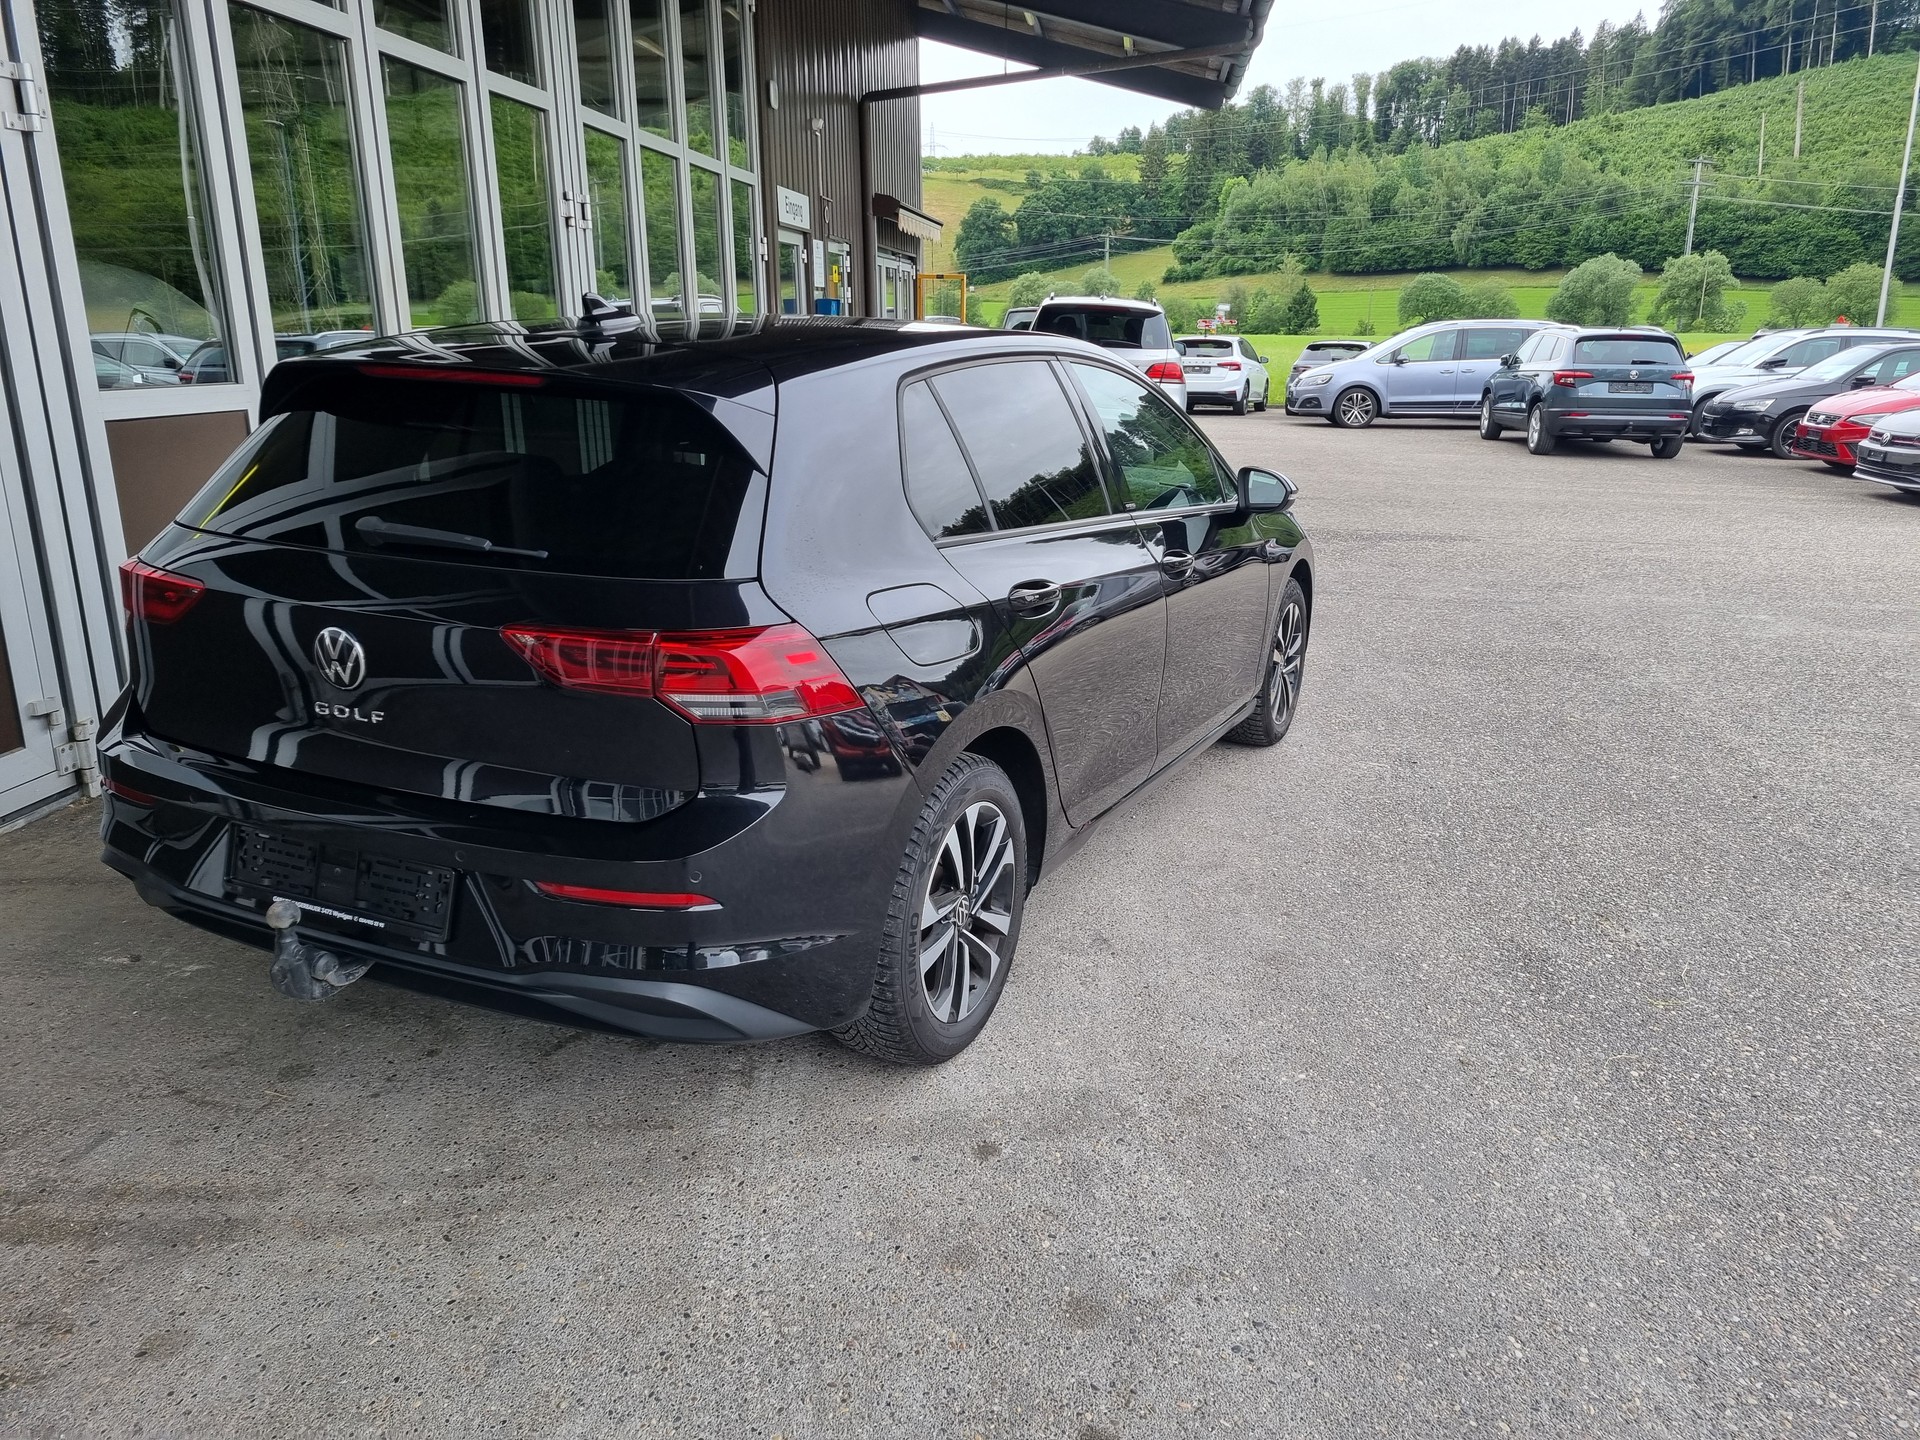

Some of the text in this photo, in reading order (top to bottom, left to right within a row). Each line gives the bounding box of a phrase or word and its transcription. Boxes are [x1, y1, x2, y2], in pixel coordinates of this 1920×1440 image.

[784, 195, 803, 223] Eingang
[314, 701, 385, 724] GOLF
[906, 912, 920, 1000] KUMHO
